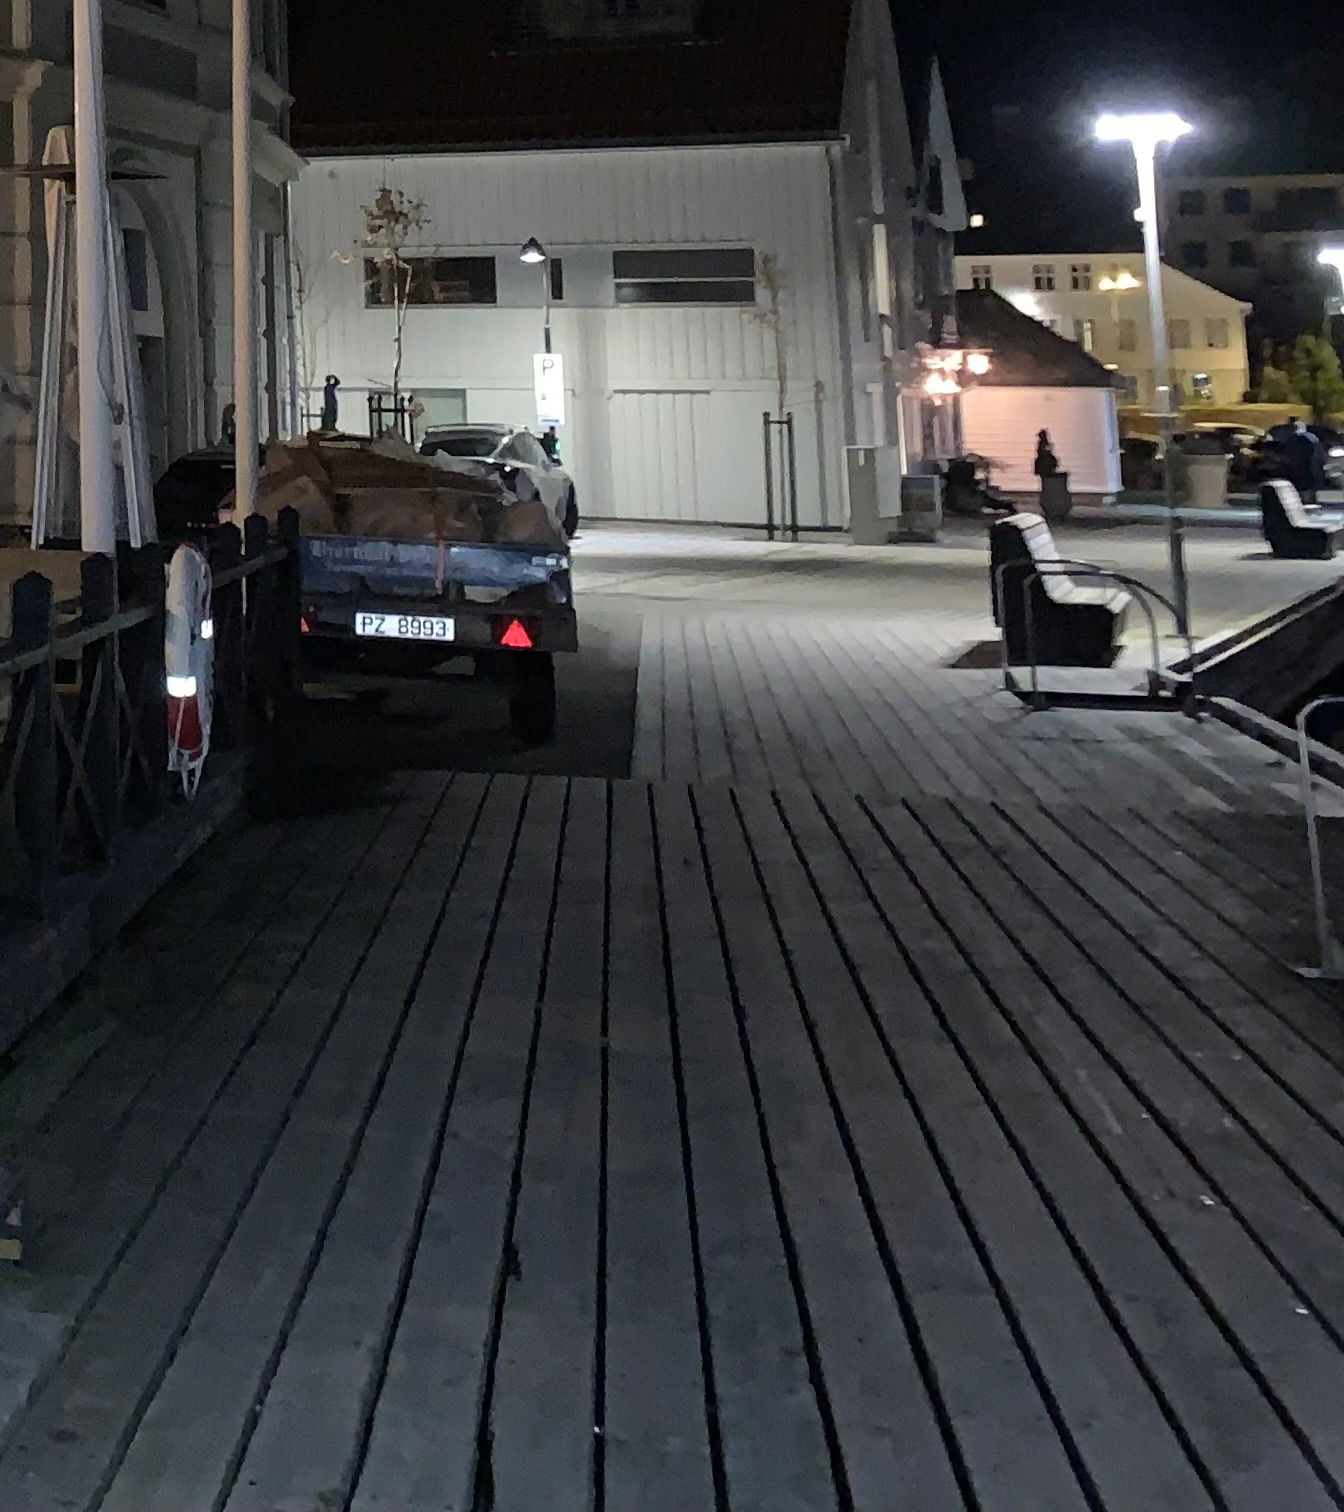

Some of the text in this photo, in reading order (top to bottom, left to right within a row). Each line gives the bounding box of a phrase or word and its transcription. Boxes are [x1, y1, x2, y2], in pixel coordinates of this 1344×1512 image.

[542, 358, 555, 377] P
[361, 616, 447, 637] PZ 8993
